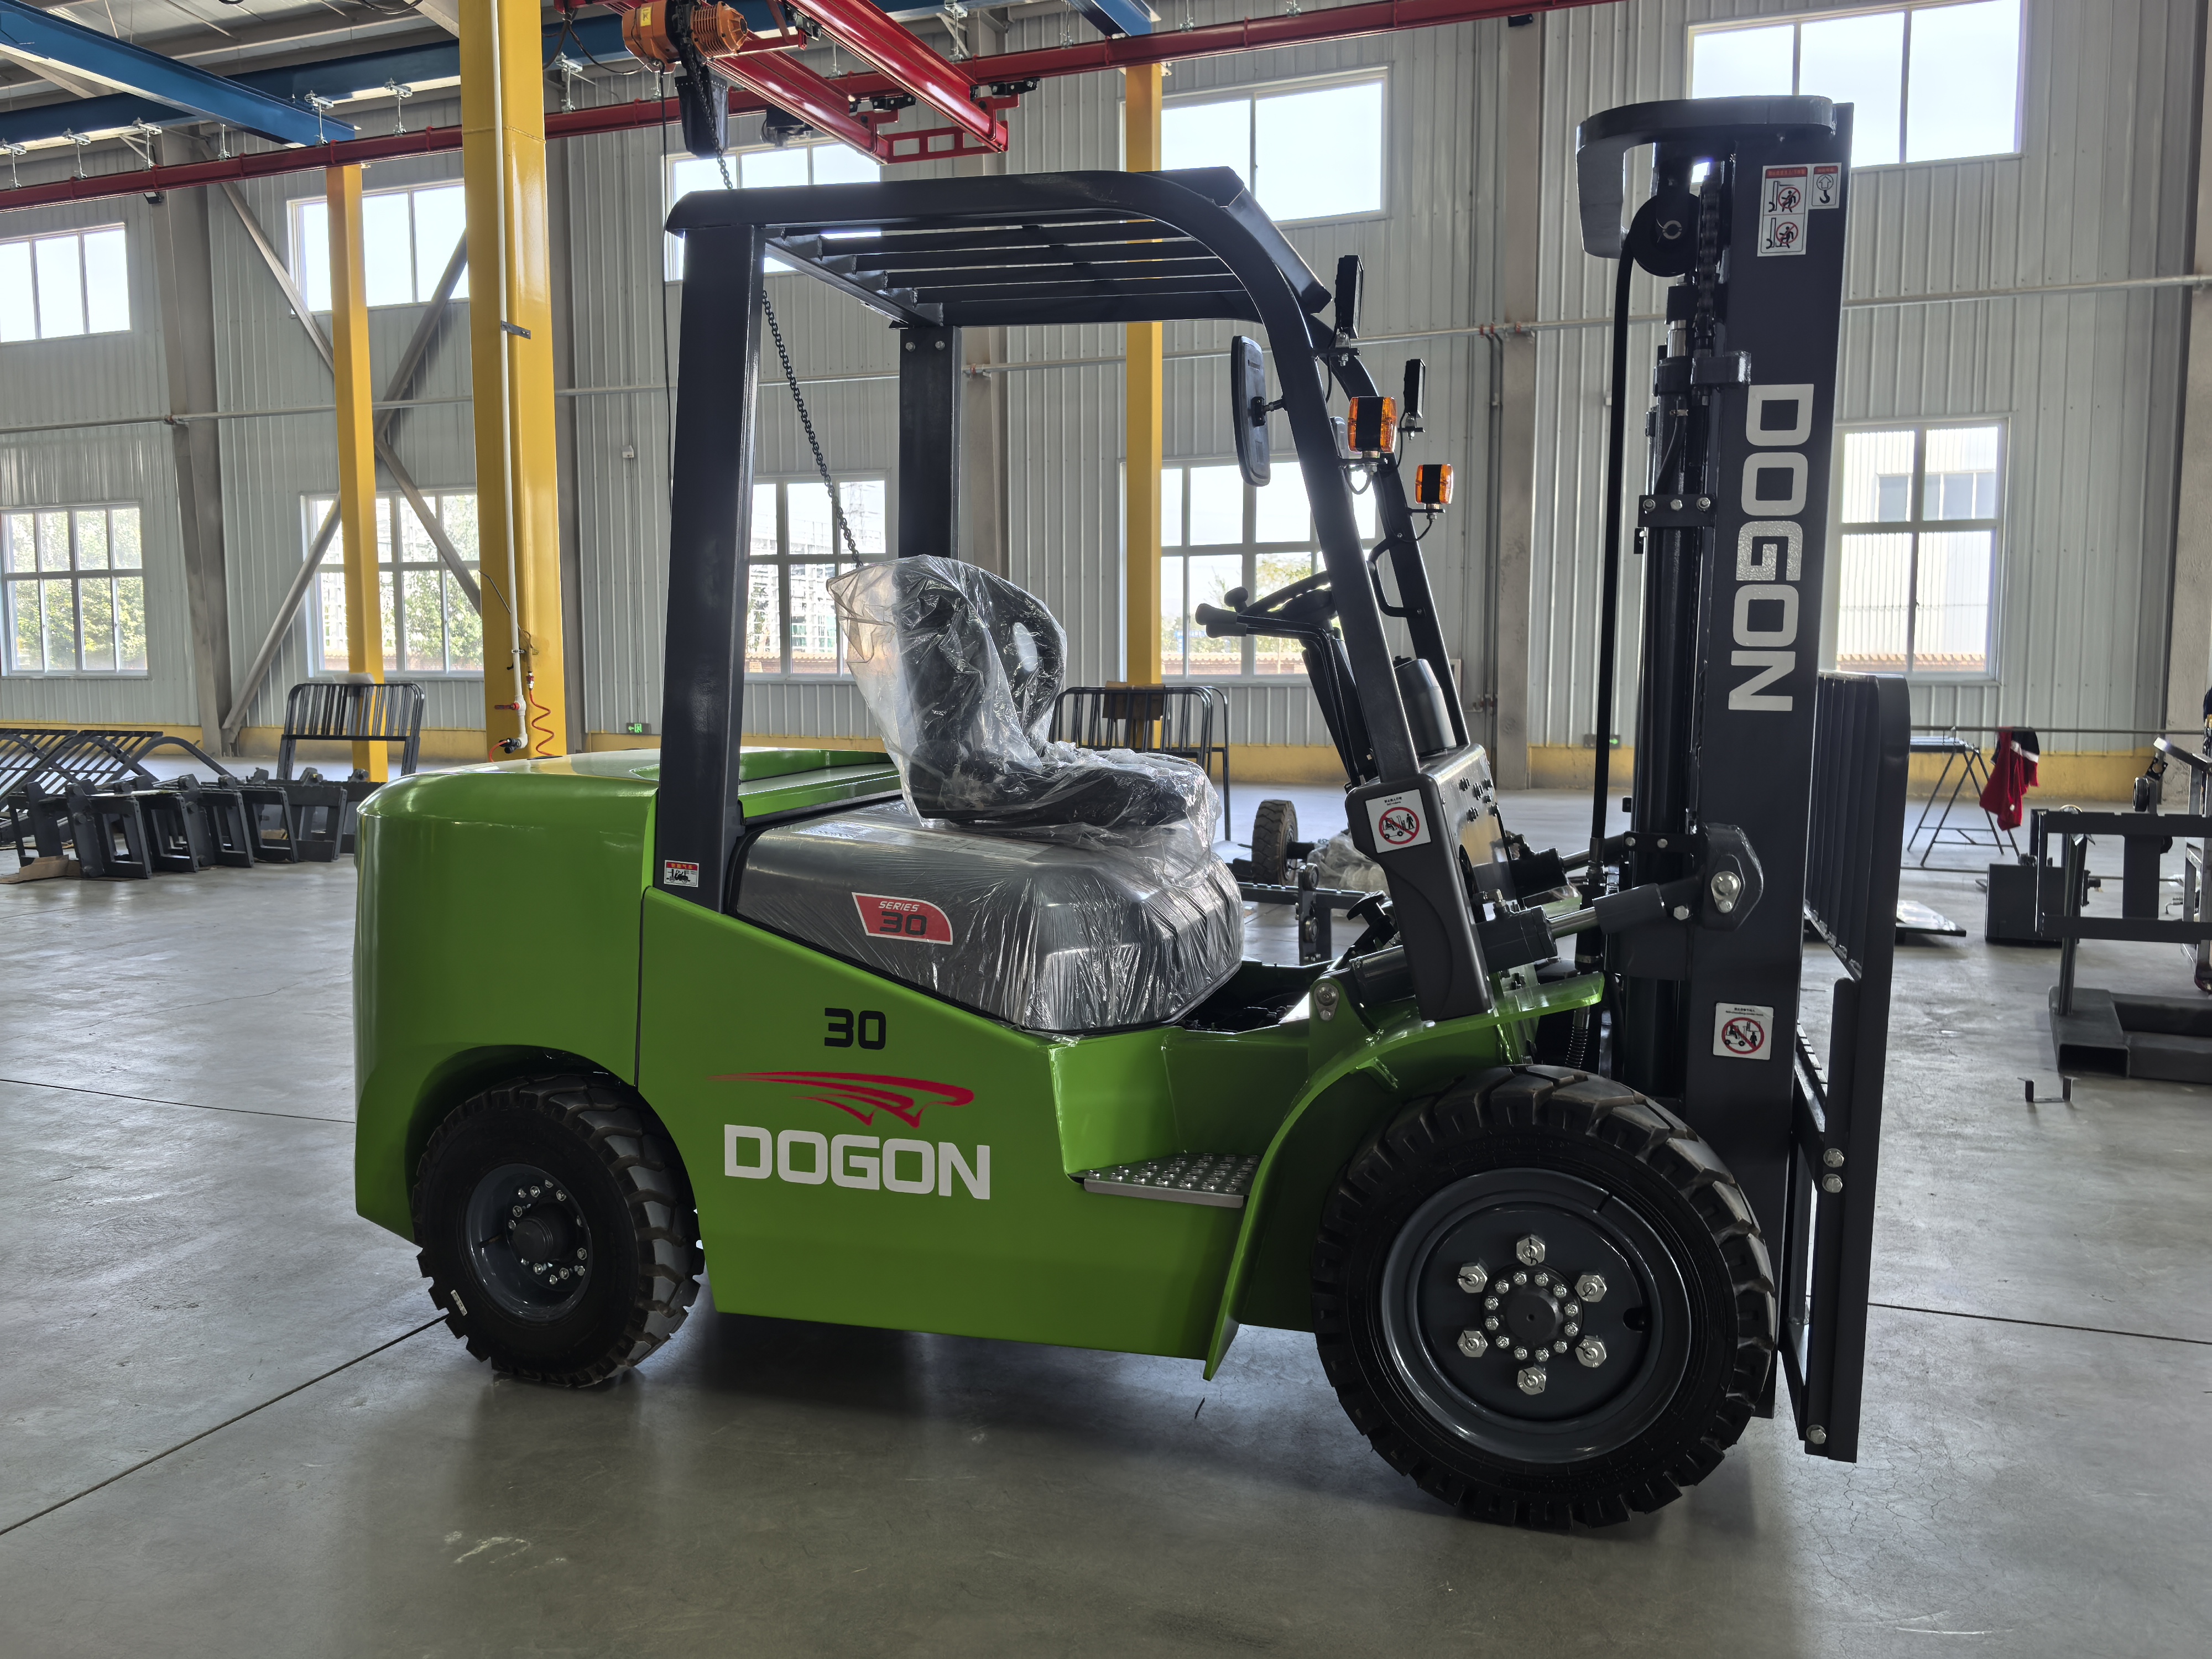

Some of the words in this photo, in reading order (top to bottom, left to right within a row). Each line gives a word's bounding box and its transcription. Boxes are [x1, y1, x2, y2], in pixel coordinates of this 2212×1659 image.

[1729, 384, 1814, 712] DOGON
[878, 900, 919, 912] SERIES
[879, 912, 927, 936] 30
[824, 1007, 886, 1050] 30
[724, 1124, 990, 1200] DOGON
